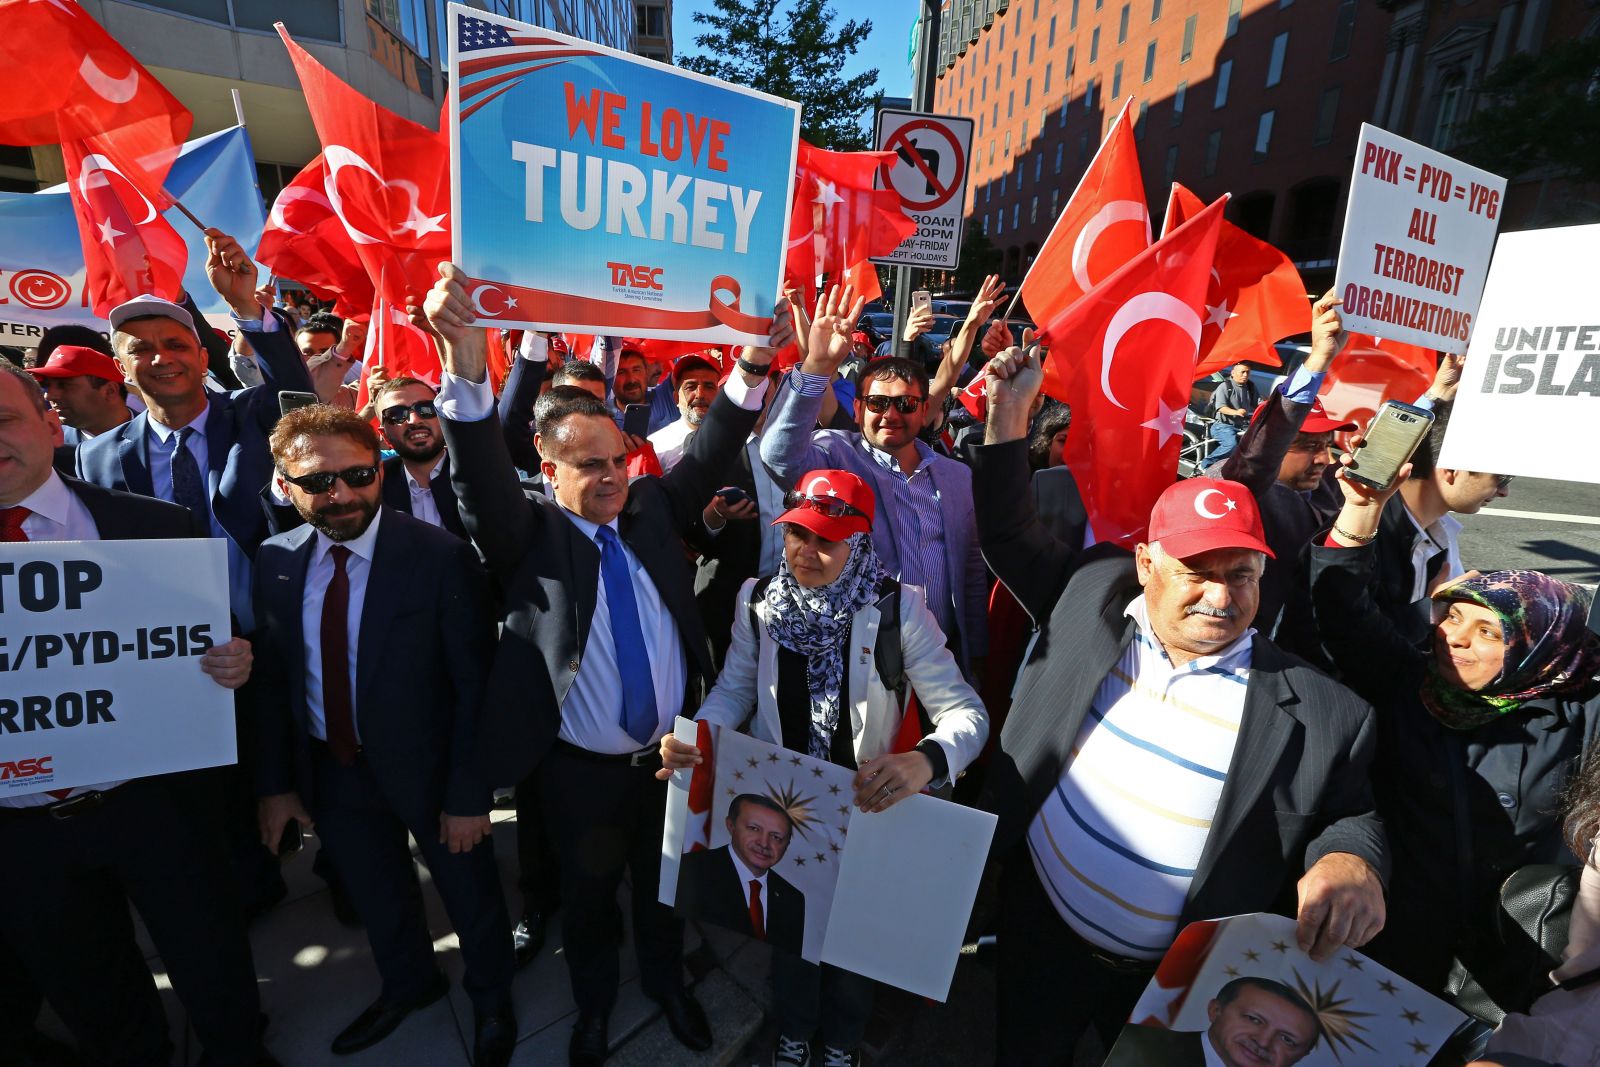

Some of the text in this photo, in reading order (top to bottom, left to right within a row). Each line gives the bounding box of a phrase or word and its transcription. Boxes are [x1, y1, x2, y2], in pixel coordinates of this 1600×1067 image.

[564, 81, 731, 172] WE LOVE
[512, 140, 763, 254] TURKEY
[1361, 141, 1403, 185] PKK
[1417, 163, 1453, 202] PYD
[1468, 182, 1499, 220] YPG
[912, 214, 955, 227] 30AM
[912, 228, 953, 239] 30PM
[1407, 207, 1437, 245] ALL
[888, 251, 948, 262] CEPT HOLIDAYS
[899, 240, 950, 251] DAY-FRIDAY
[607, 261, 664, 290] TASC
[1373, 243, 1465, 297] TERRORIST
[1342, 282, 1472, 342] ORGANIZATIONS
[1495, 325, 1600, 351] UNITE
[1480, 354, 1600, 397] ISLA
